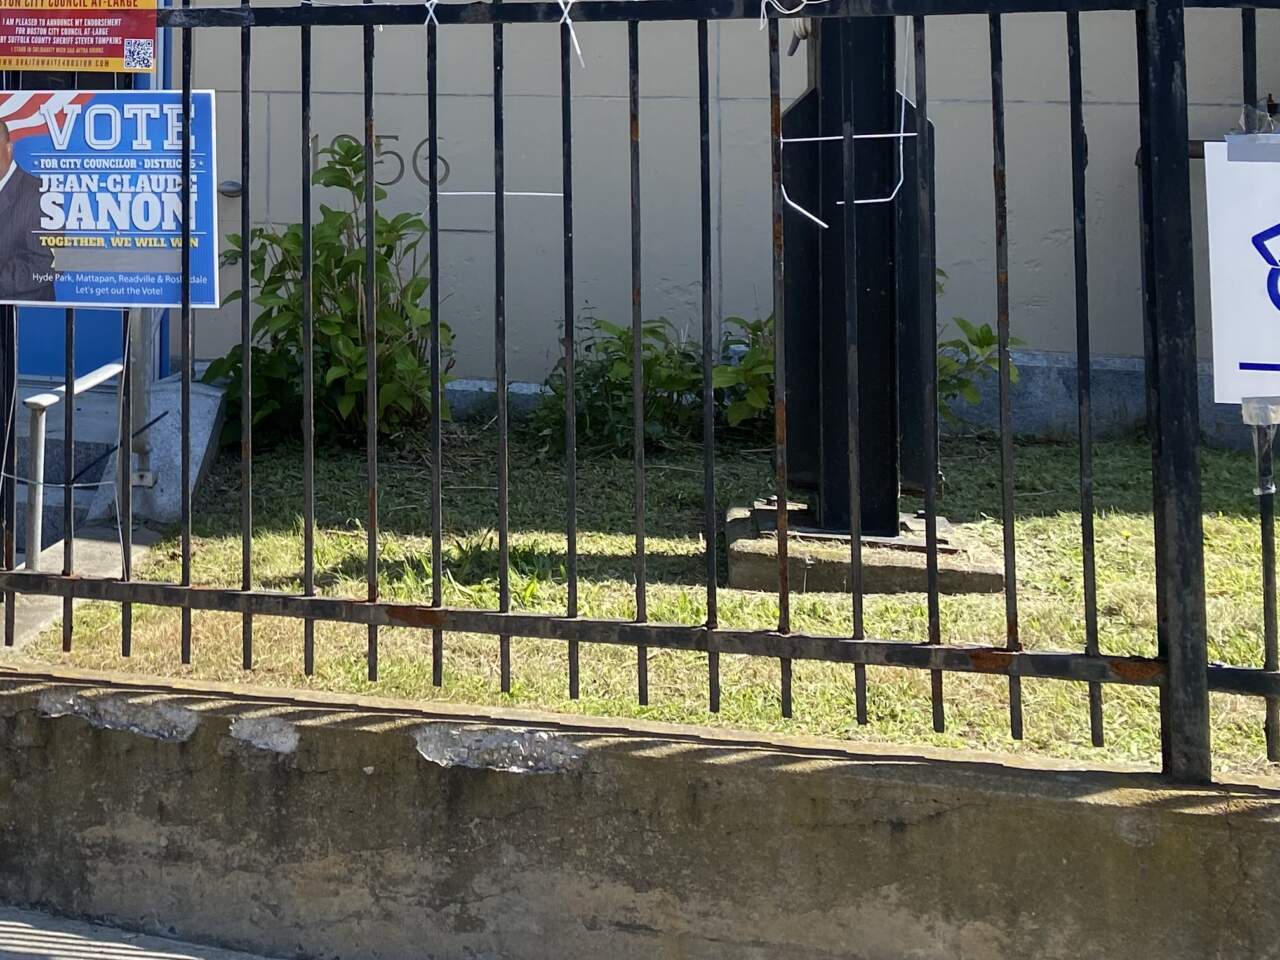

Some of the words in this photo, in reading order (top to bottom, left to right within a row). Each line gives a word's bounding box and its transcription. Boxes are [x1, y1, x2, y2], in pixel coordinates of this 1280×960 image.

[48, 27, 60, 36] CITY
[39, 103, 196, 151] VOTE
[40, 158, 58, 169] FOR
[59, 158, 82, 169] CITY
[83, 158, 137, 169] COUNCILOR
[144, 158, 183, 170] DISTRIC
[40, 192, 198, 231] SANON
[39, 236, 108, 248] TOGETHER,
[110, 237, 132, 248] WE
[135, 237, 167, 248] WILL
[170, 237, 199, 248] WN
[32, 273, 54, 284] Hyde
[55, 273, 73, 283] Park,
[76, 274, 117, 284] Mattapan,
[118, 274, 156, 284] Readville
[156, 275, 164, 284] &
[165, 275, 208, 284] Rosldale
[75, 286, 95, 295] Let's
[95, 287, 110, 297] get
[111, 287, 125, 295] out
[126, 286, 141, 295] the
[141, 287, 164, 296] Vote!
